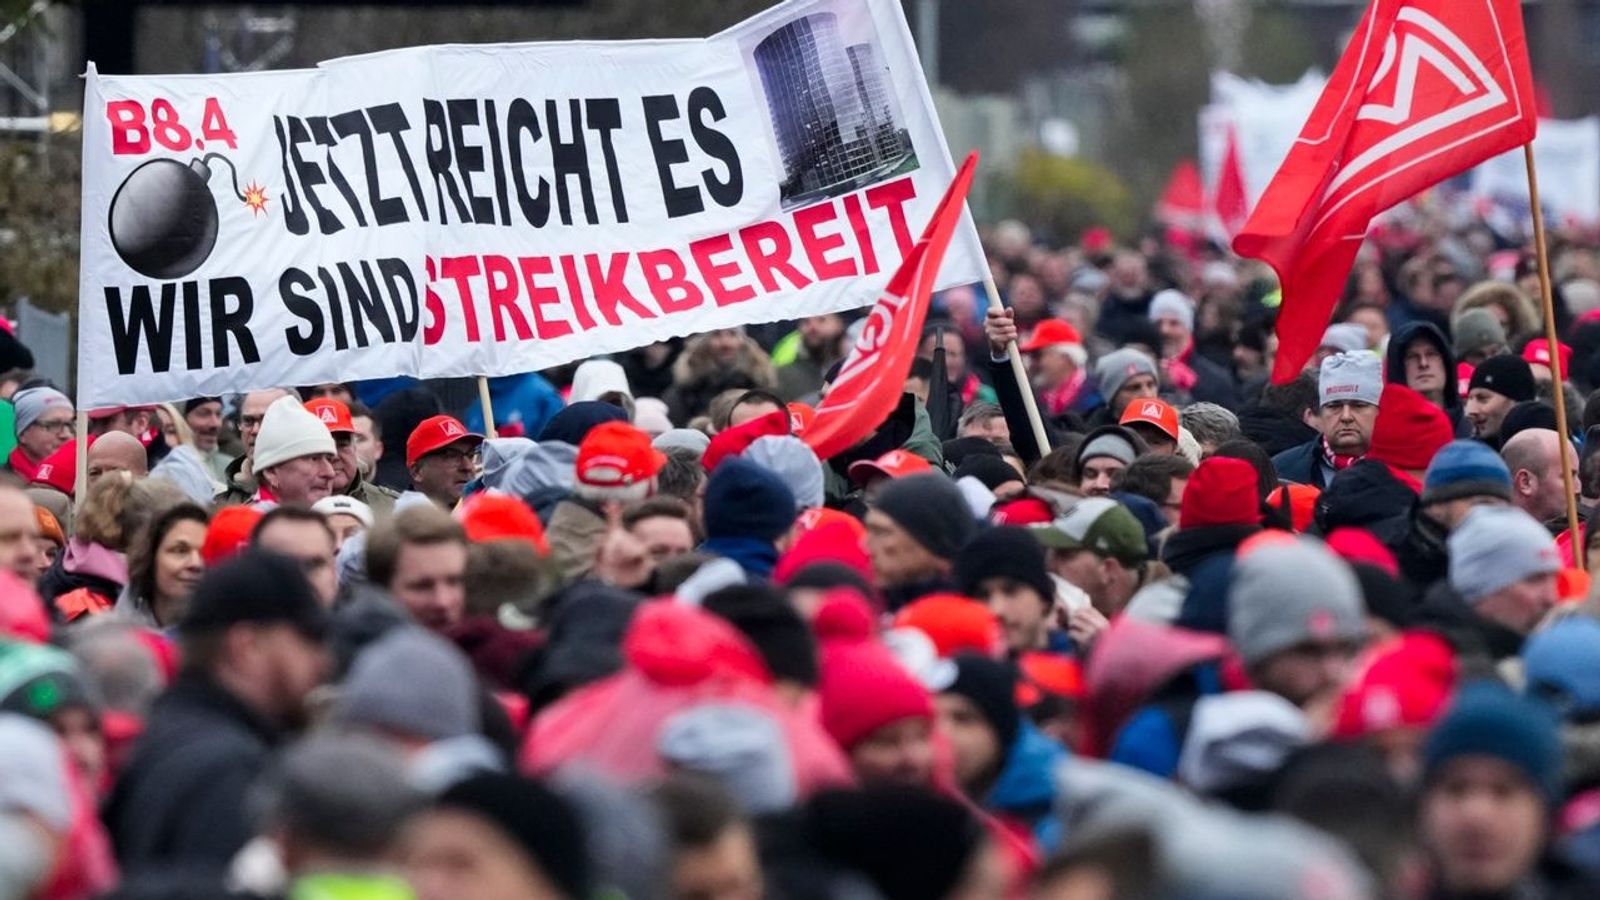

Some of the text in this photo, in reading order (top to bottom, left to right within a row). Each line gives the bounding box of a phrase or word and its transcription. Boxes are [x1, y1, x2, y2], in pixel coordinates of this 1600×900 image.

[106, 97, 237, 155] B8.4
[273, 86, 744, 235] JETZT REICHT ES
[104, 177, 917, 375] WIR SIND STREIKBEREIT
